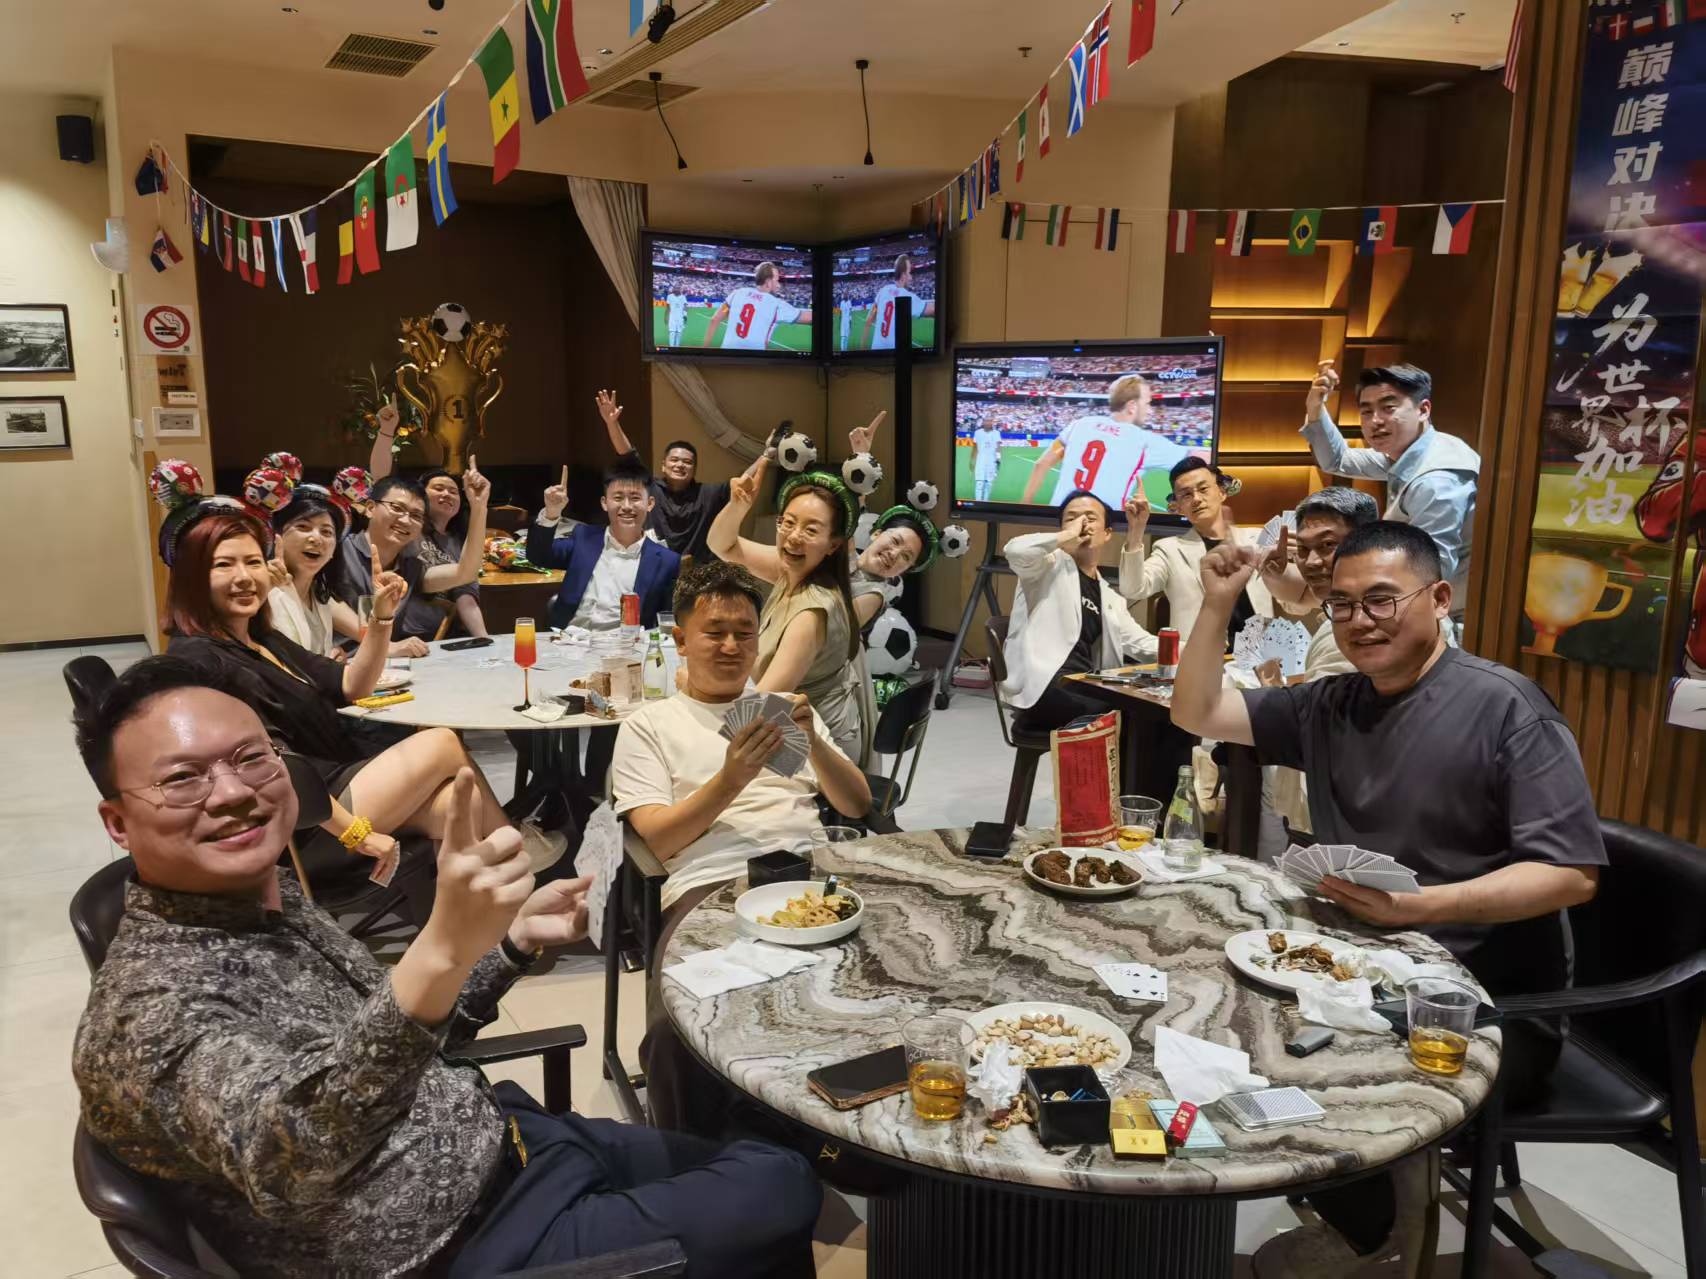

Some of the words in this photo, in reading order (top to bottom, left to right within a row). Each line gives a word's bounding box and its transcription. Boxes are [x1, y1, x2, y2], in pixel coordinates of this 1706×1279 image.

[1604, 41, 1673, 233] 巅峰对决
[735, 303, 755, 339] 9
[880, 301, 894, 337] 9
[452, 400, 464, 419] 1
[1556, 293, 1687, 526] 为世界杯加油
[1073, 439, 1107, 492] 9
